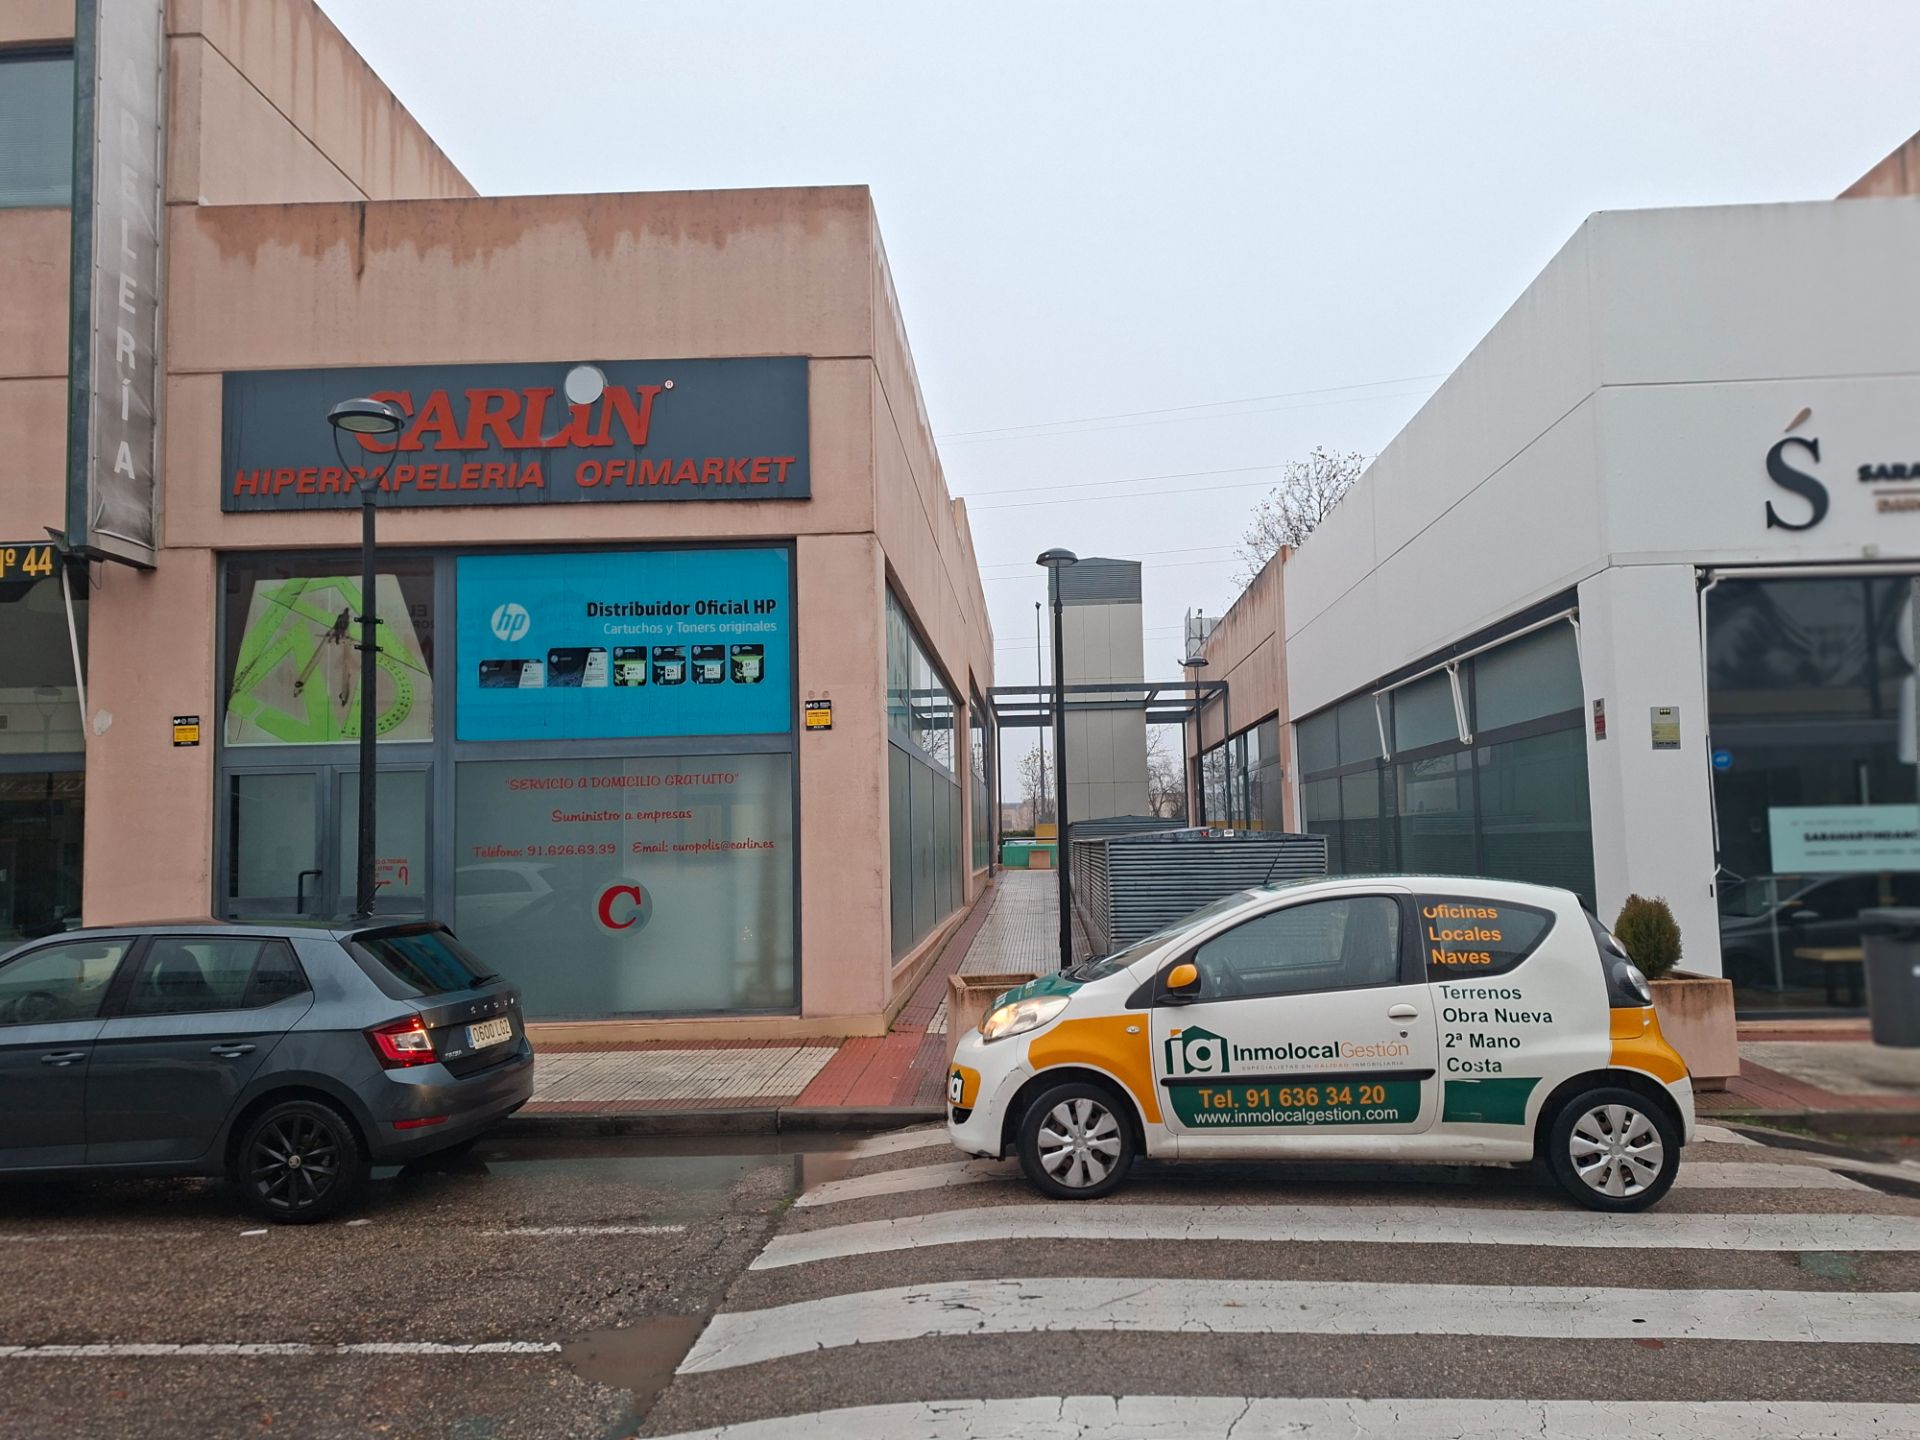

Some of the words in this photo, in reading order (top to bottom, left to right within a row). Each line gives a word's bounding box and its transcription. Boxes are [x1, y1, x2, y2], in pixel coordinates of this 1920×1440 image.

[232, 461, 546, 497] HIPERPAPELERIA
[575, 456, 796, 488] OFIMARKET
[22, 546, 52, 577] 44
[587, 601, 690, 617] Distribuidor
[695, 600, 749, 616] Oficial
[754, 599, 776, 615] HP
[603, 622, 663, 634] Cartuchos
[666, 624, 673, 635] y
[676, 621, 716, 633] Toners
[719, 620, 777, 634] originales
[591, 775, 661, 788] DOMICILIO
[551, 809, 621, 823] Suministro
[624, 812, 633, 821] a
[636, 810, 694, 823] empresas
[632, 840, 669, 854] Email:
[598, 885, 641, 929] C
[1428, 926, 1502, 942] Locales
[1431, 949, 1491, 964] Naves
[1439, 985, 1522, 1000] Terrenos
[1443, 1008, 1488, 1023] Obra
[1495, 1008, 1553, 1023] Nueva
[473, 1024, 495, 1043] 0600
[1445, 1033, 1463, 1048] 2ª
[1469, 1034, 1521, 1048] Mano
[1447, 1057, 1502, 1072] Costa
[1199, 1090, 1239, 1108] Tel.
[1246, 1089, 1270, 1107] 91
[1279, 1088, 1319, 1106] 636
[1326, 1086, 1352, 1105] 34
[1359, 1086, 1385, 1104] 20
[1194, 1107, 1398, 1124] www.inmolocalgestion.com
